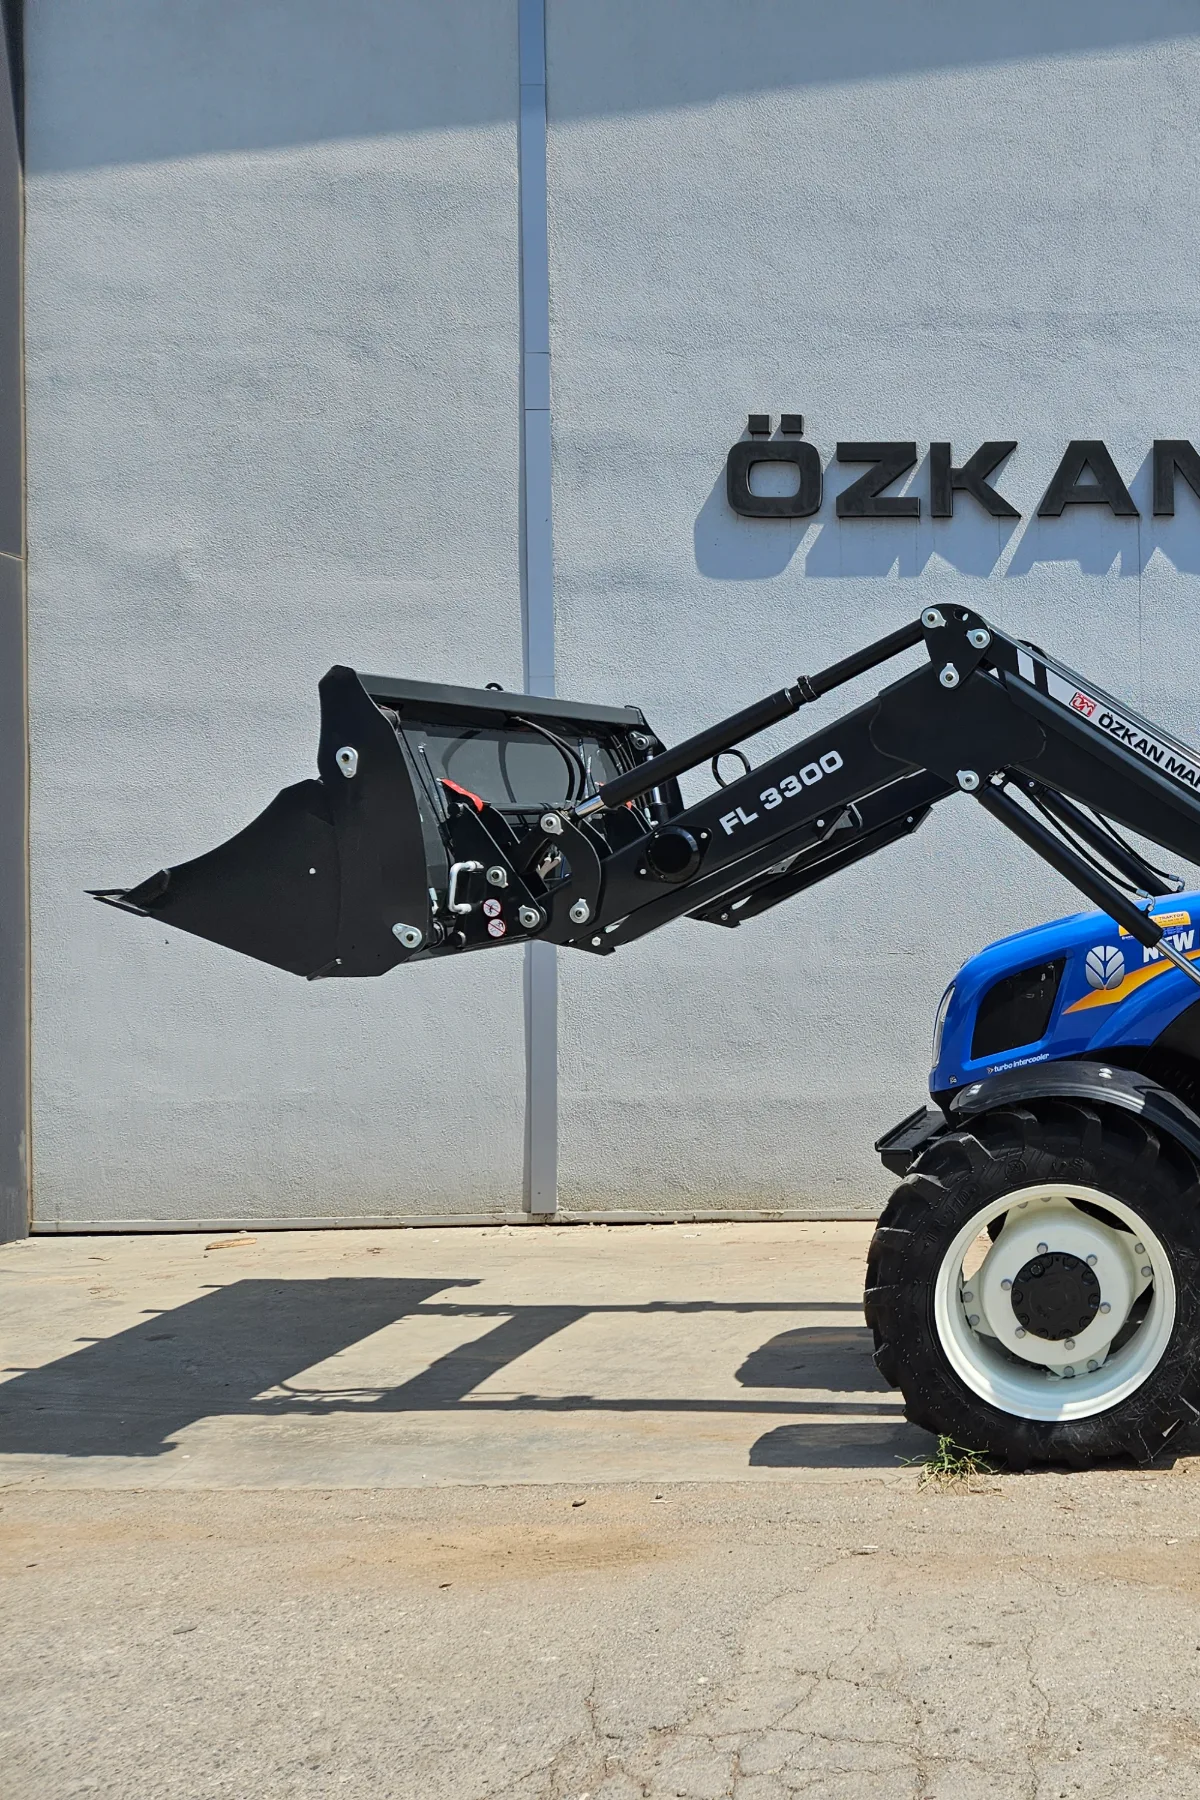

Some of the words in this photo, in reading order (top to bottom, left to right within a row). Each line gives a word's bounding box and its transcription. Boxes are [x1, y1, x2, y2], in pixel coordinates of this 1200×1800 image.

[1098, 711, 1165, 764] ÖZKAN
[718, 806, 760, 836] FL
[759, 750, 844, 810] 3300
[993, 1062, 1013, 1073] turbo
[1013, 1053, 1050, 1067] intercooler
